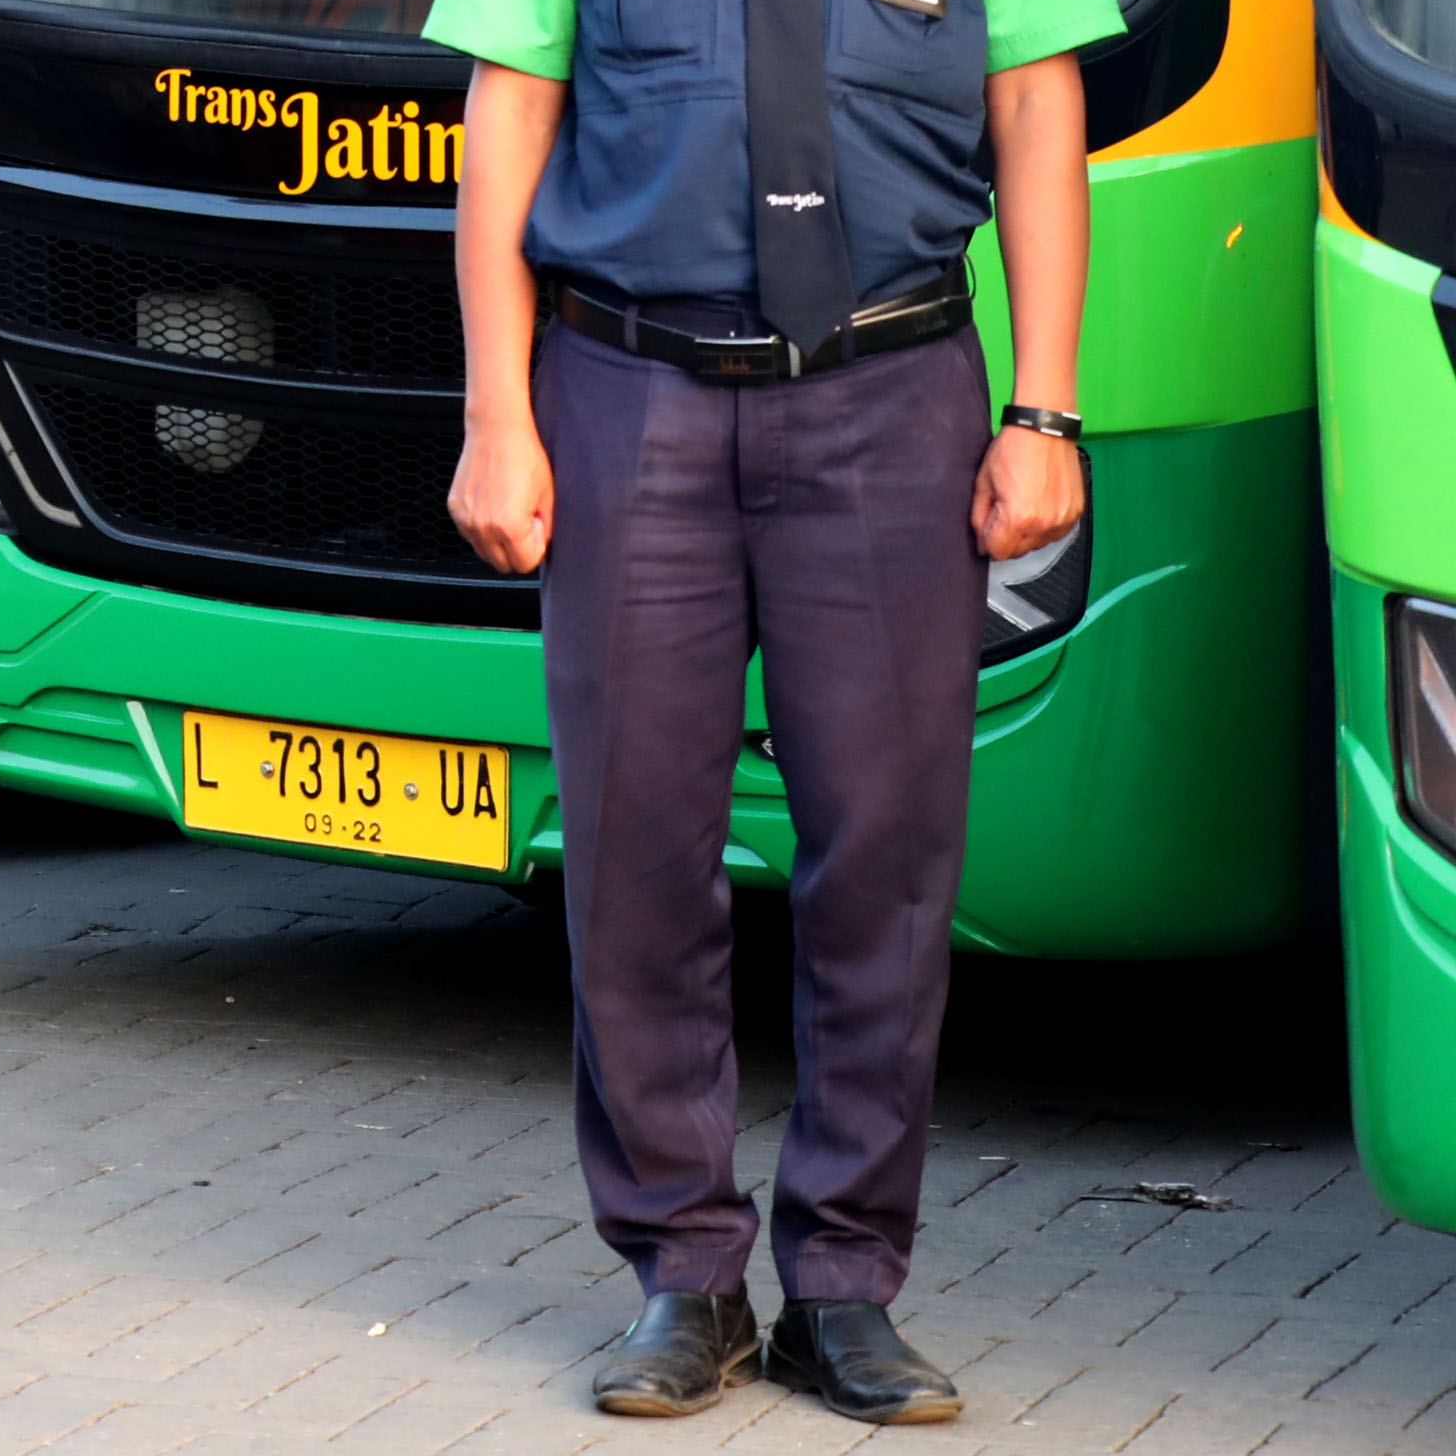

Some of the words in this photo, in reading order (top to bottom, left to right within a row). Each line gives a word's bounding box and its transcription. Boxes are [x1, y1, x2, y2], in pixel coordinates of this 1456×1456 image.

[154, 68, 277, 132] Trans
[194, 722, 219, 789] L
[269, 730, 382, 807] 7313
[439, 749, 498, 819] UA
